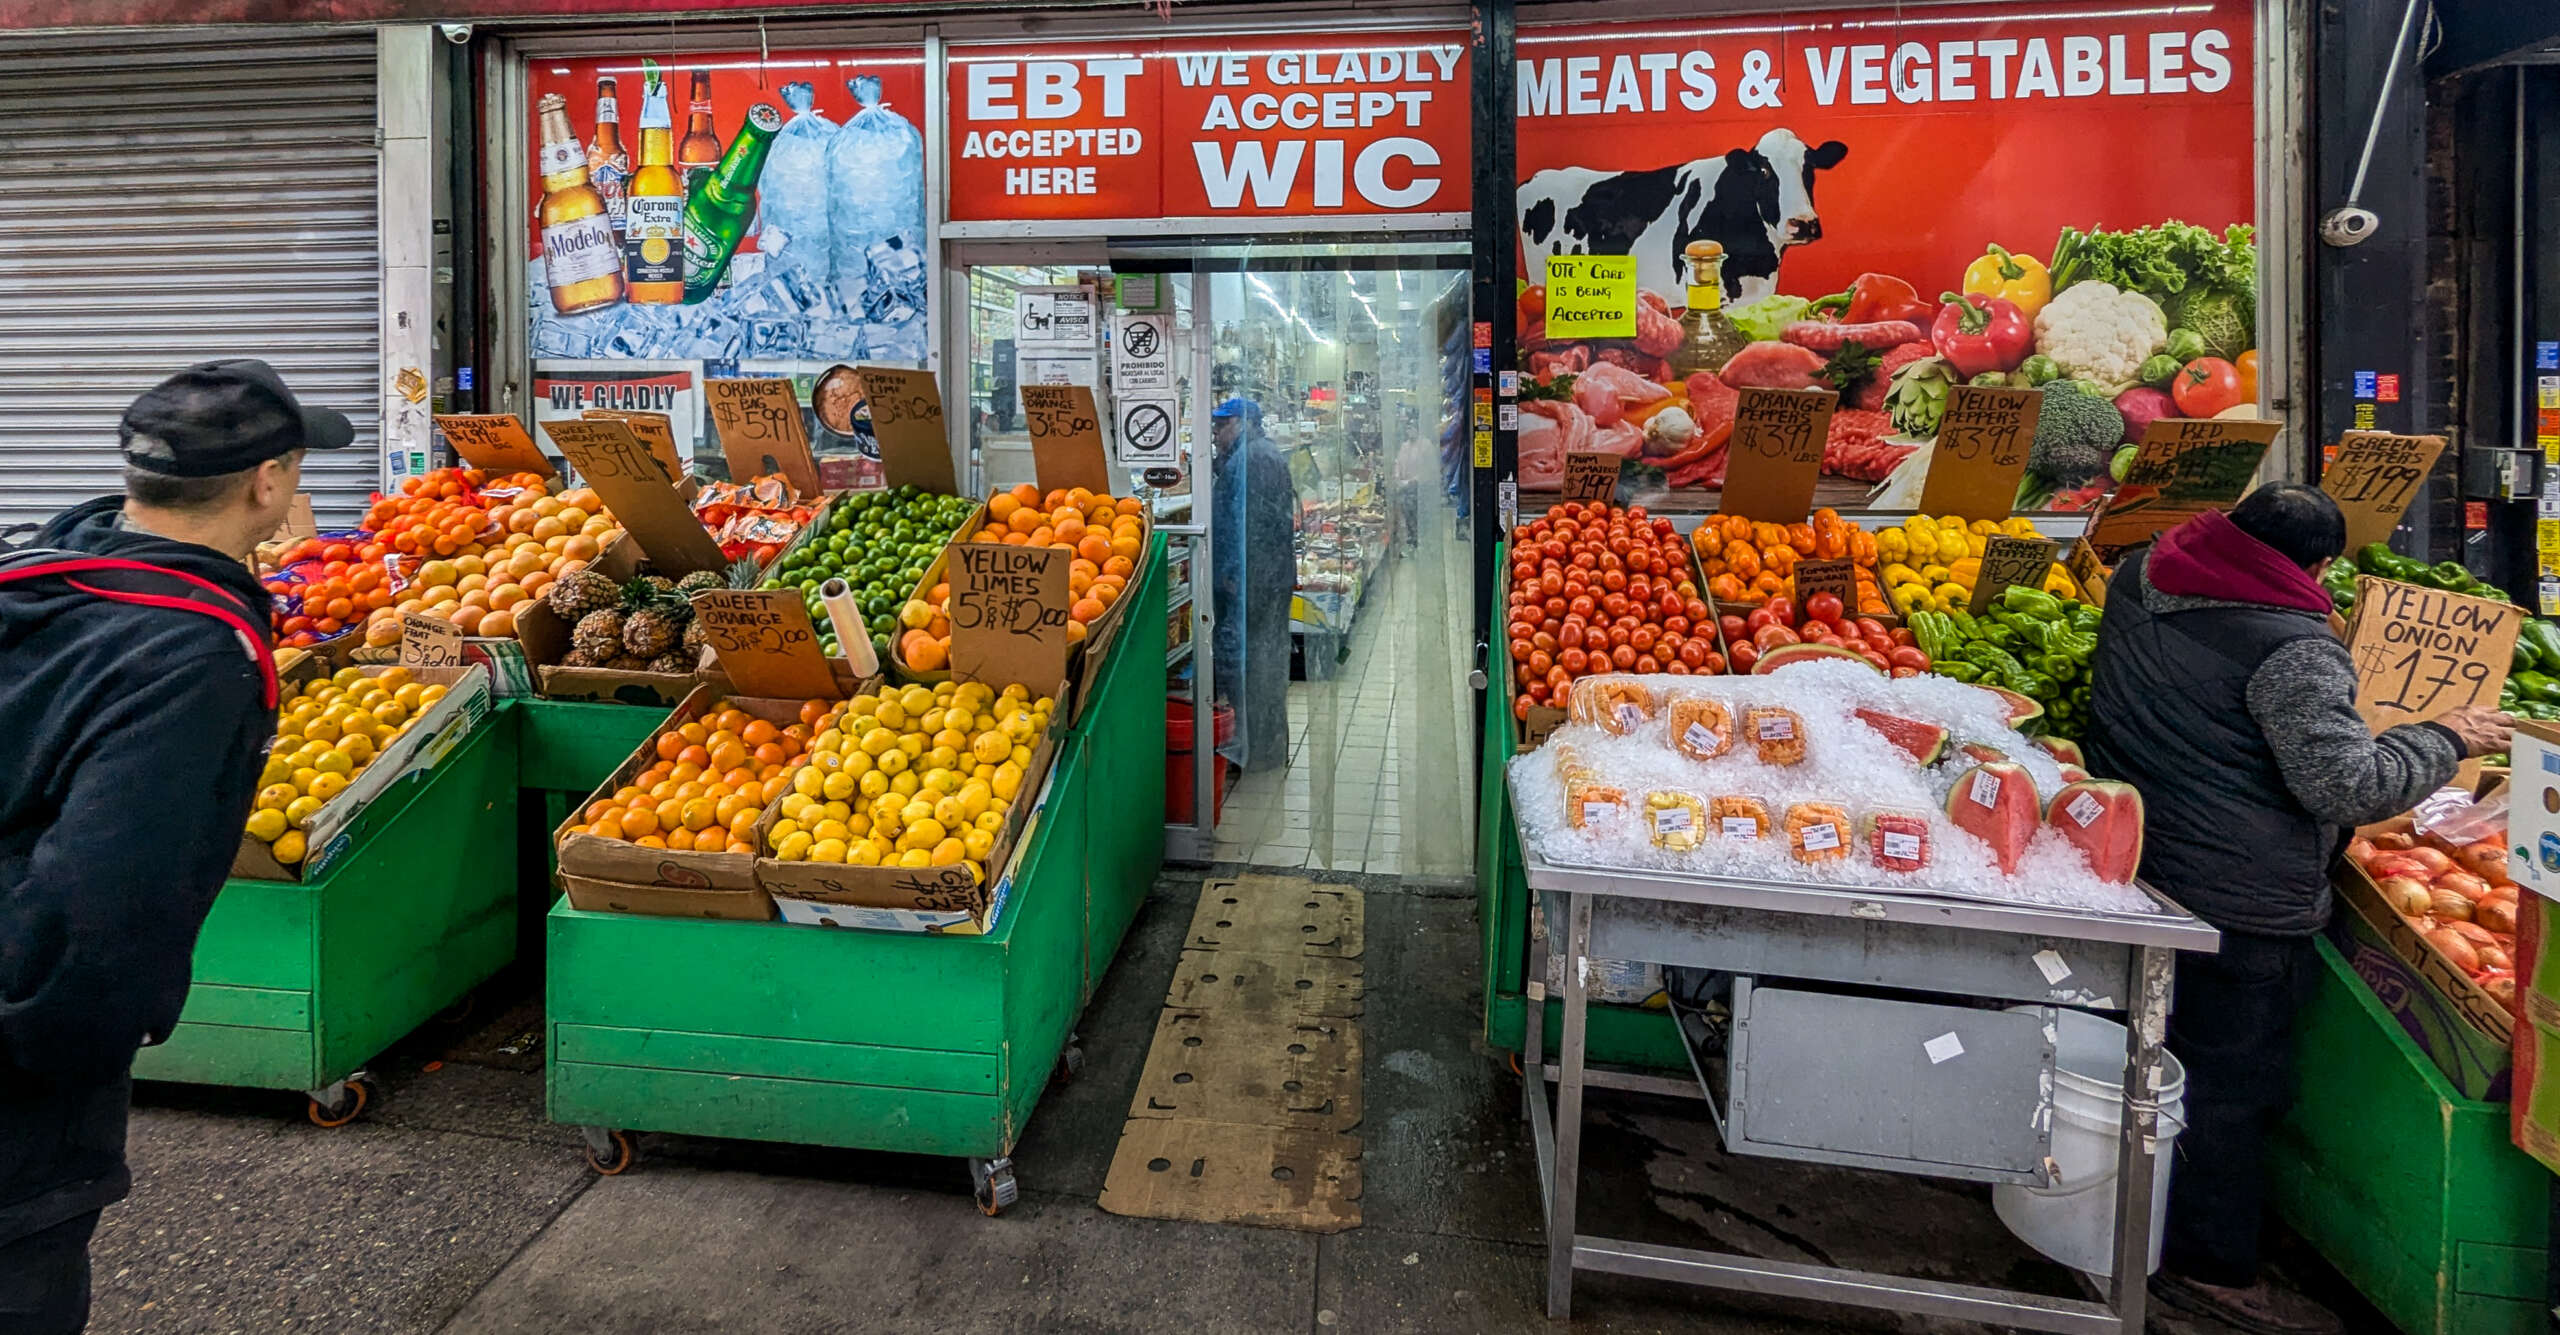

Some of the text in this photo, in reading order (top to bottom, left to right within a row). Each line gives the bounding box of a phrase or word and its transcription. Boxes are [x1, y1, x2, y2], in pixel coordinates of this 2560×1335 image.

[1176, 44, 1465, 87] WE GLADLY
[1516, 29, 2232, 117] MEATS & VEGETABLES
[966, 59, 1144, 121] EBT
[1201, 90, 1433, 131] ACCEPT
[961, 128, 1142, 159] ACCEPTED
[1005, 166, 1097, 196] HERE
[1192, 136, 1442, 209] WIC
[632, 197, 679, 216] Corona
[643, 212, 672, 223] Extra
[551, 227, 605, 257] Modelo
[1059, 316, 1085, 324] AVISO
[1121, 361, 1165, 370] PROHIBIDO
[551, 385, 676, 410] WE GLADLY
[718, 382, 781, 398] ORANGE
[1024, 389, 1064, 399] SWEET
[740, 397, 767, 411] BAG
[1026, 399, 1076, 410] ORANGE
[1748, 391, 1827, 413] ORANGE
[1957, 389, 2029, 411] YELLOW
[1028, 411, 1048, 438] 3
[1738, 407, 1812, 425] PEPPERS
[1944, 409, 2020, 426] PEPPERS
[548, 424, 597, 436] SWEET
[2180, 422, 2224, 440] RED
[2347, 437, 2421, 452] GREEN
[1792, 453, 1819, 463] LBS
[1993, 455, 2020, 466] LBS
[2340, 450, 2425, 465] PEPPERS
[960, 548, 1050, 575] YELLOW
[970, 574, 1040, 594] LIMES
[700, 594, 774, 611] SWEET
[955, 592, 982, 628] 5
[2382, 582, 2505, 635] YELLOW
[404, 616, 446, 635] ORANGE
[404, 627, 430, 640] FRUIT
[710, 626, 740, 652] 3
[2384, 621, 2479, 656] ONION
[405, 638, 422, 664] 3
